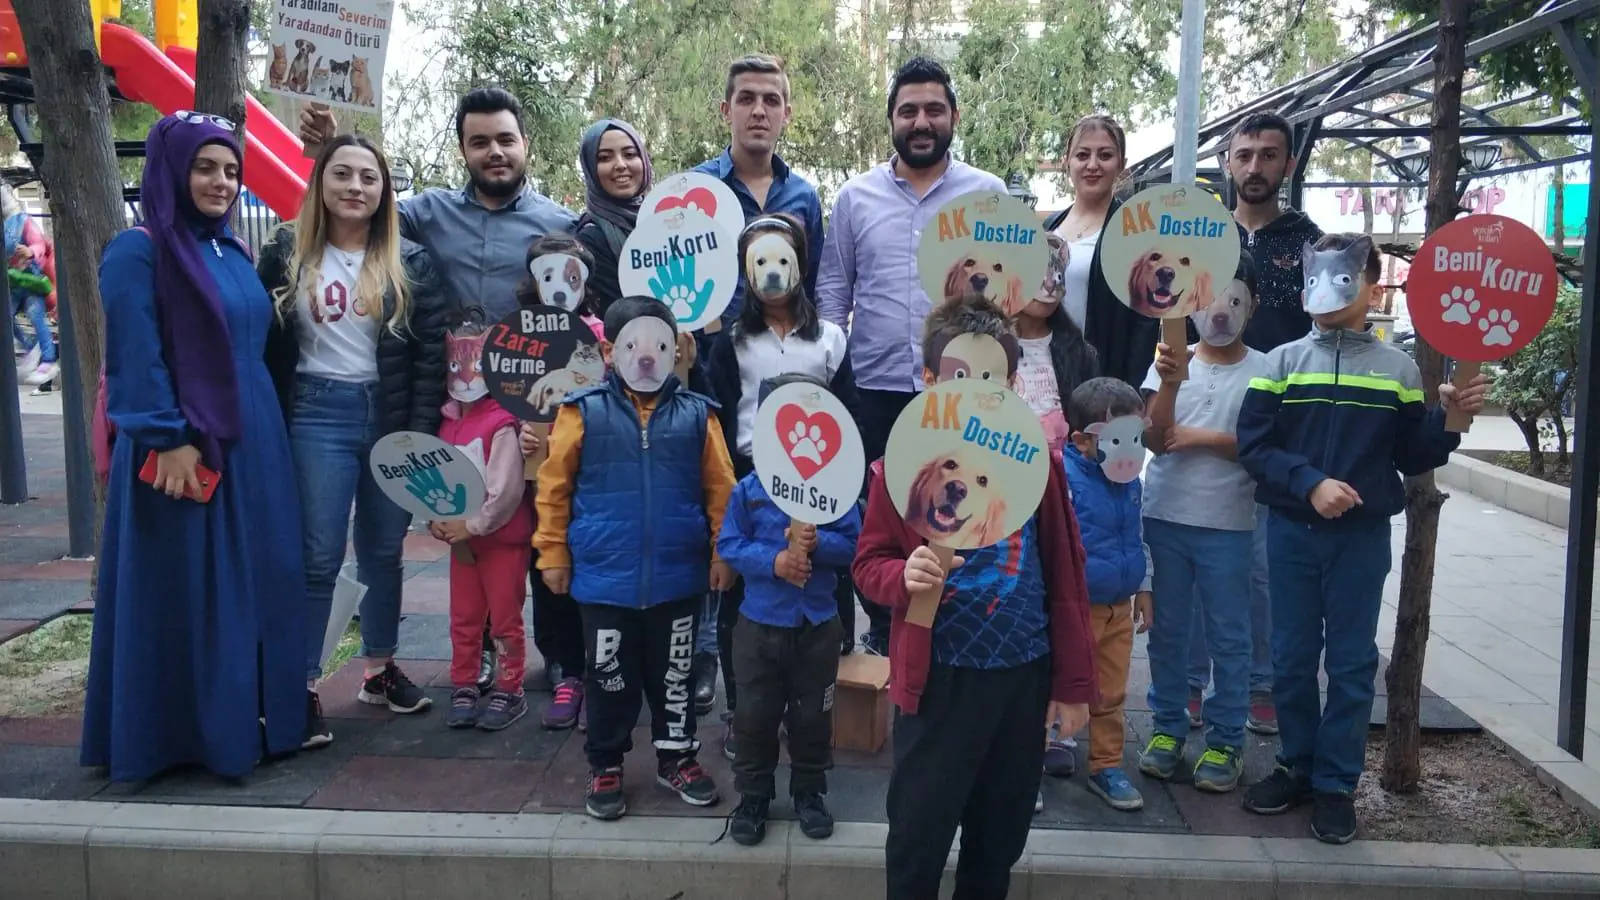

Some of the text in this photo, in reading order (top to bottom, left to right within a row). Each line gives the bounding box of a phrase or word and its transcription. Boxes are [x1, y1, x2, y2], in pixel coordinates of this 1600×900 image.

[278, 12, 381, 49] Yaradandan Ötürü
[338, 7, 387, 30] Severim
[938, 207, 1037, 245] AK Dostlar
[1122, 200, 1156, 236] AK
[1160, 214, 1227, 238] Dostlar
[630, 231, 718, 270] Beni Koru
[1434, 245, 1543, 296] Beni Koru
[493, 323, 550, 357] Zarar
[520, 310, 571, 334] Bana
[489, 352, 546, 375] Verme
[920, 391, 1040, 464] AK Dostlar
[378, 447, 454, 479] Beni Koru
[772, 475, 838, 514] Beni Sev
